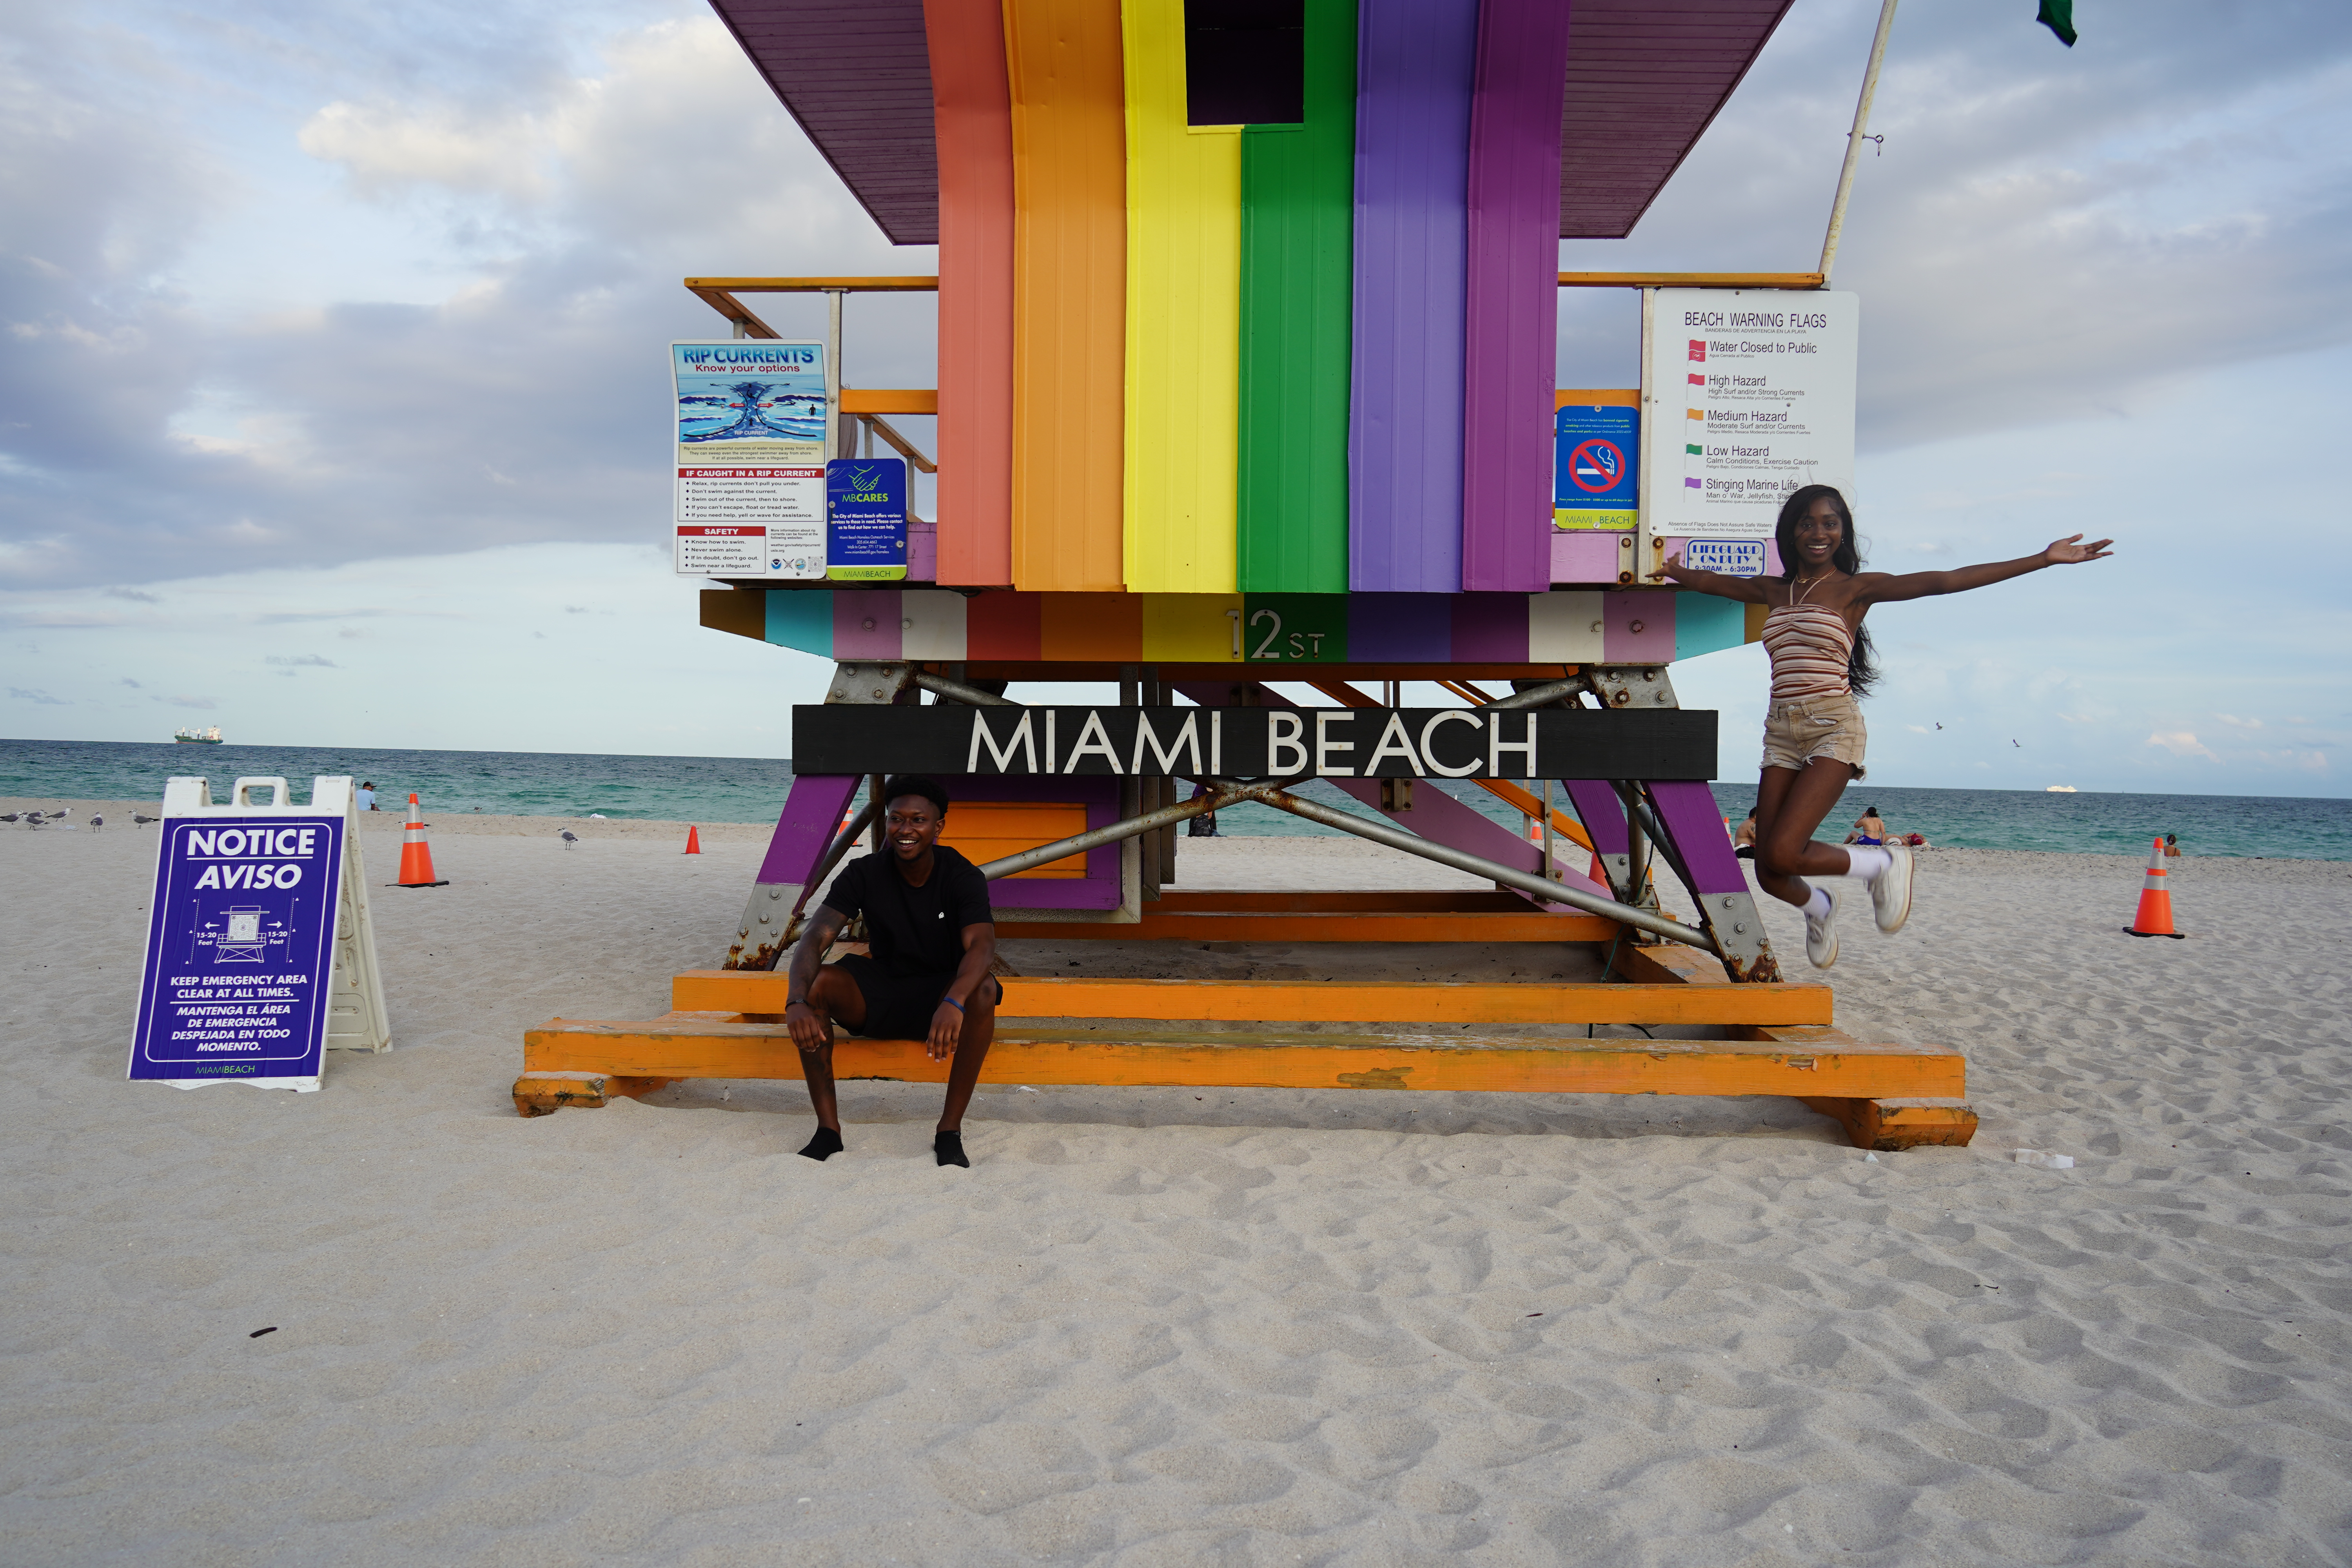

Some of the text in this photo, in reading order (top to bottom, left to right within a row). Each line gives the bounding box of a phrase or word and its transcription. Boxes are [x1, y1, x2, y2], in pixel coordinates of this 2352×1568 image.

[1686, 312, 1826, 328] BEACH WARNING FLAGS
[1710, 341, 1817, 353] Water Closed to Public
[684, 348, 814, 364] RIP CURRENTS
[759, 365, 800, 373] options
[1710, 375, 1766, 388] High Hazard
[1708, 410, 1787, 421] Medium Hazard
[1708, 445, 1769, 456] Low Hazard
[1706, 478, 1798, 492] Stinging Marine Life
[1693, 545, 1759, 554] LIFEGUARD
[1700, 555, 1751, 564] ON DUTY
[1226, 609, 1325, 659] 12 ST
[967, 709, 1537, 777] MIAMI BEACH
[187, 829, 315, 855] NOTICE
[194, 864, 302, 889] AVISO
[171, 975, 307, 985] KEEP EMERGENCY AREA
[177, 987, 293, 998] CLEAR AT ALL TIMES.
[176, 1004, 290, 1015] MANTENGA EL ÁREA
[205, 1018, 277, 1027] EMERGENCIA
[172, 1029, 290, 1040] DESPEJADA EN TODO
[196, 1042, 261, 1051] MOMENTO.
